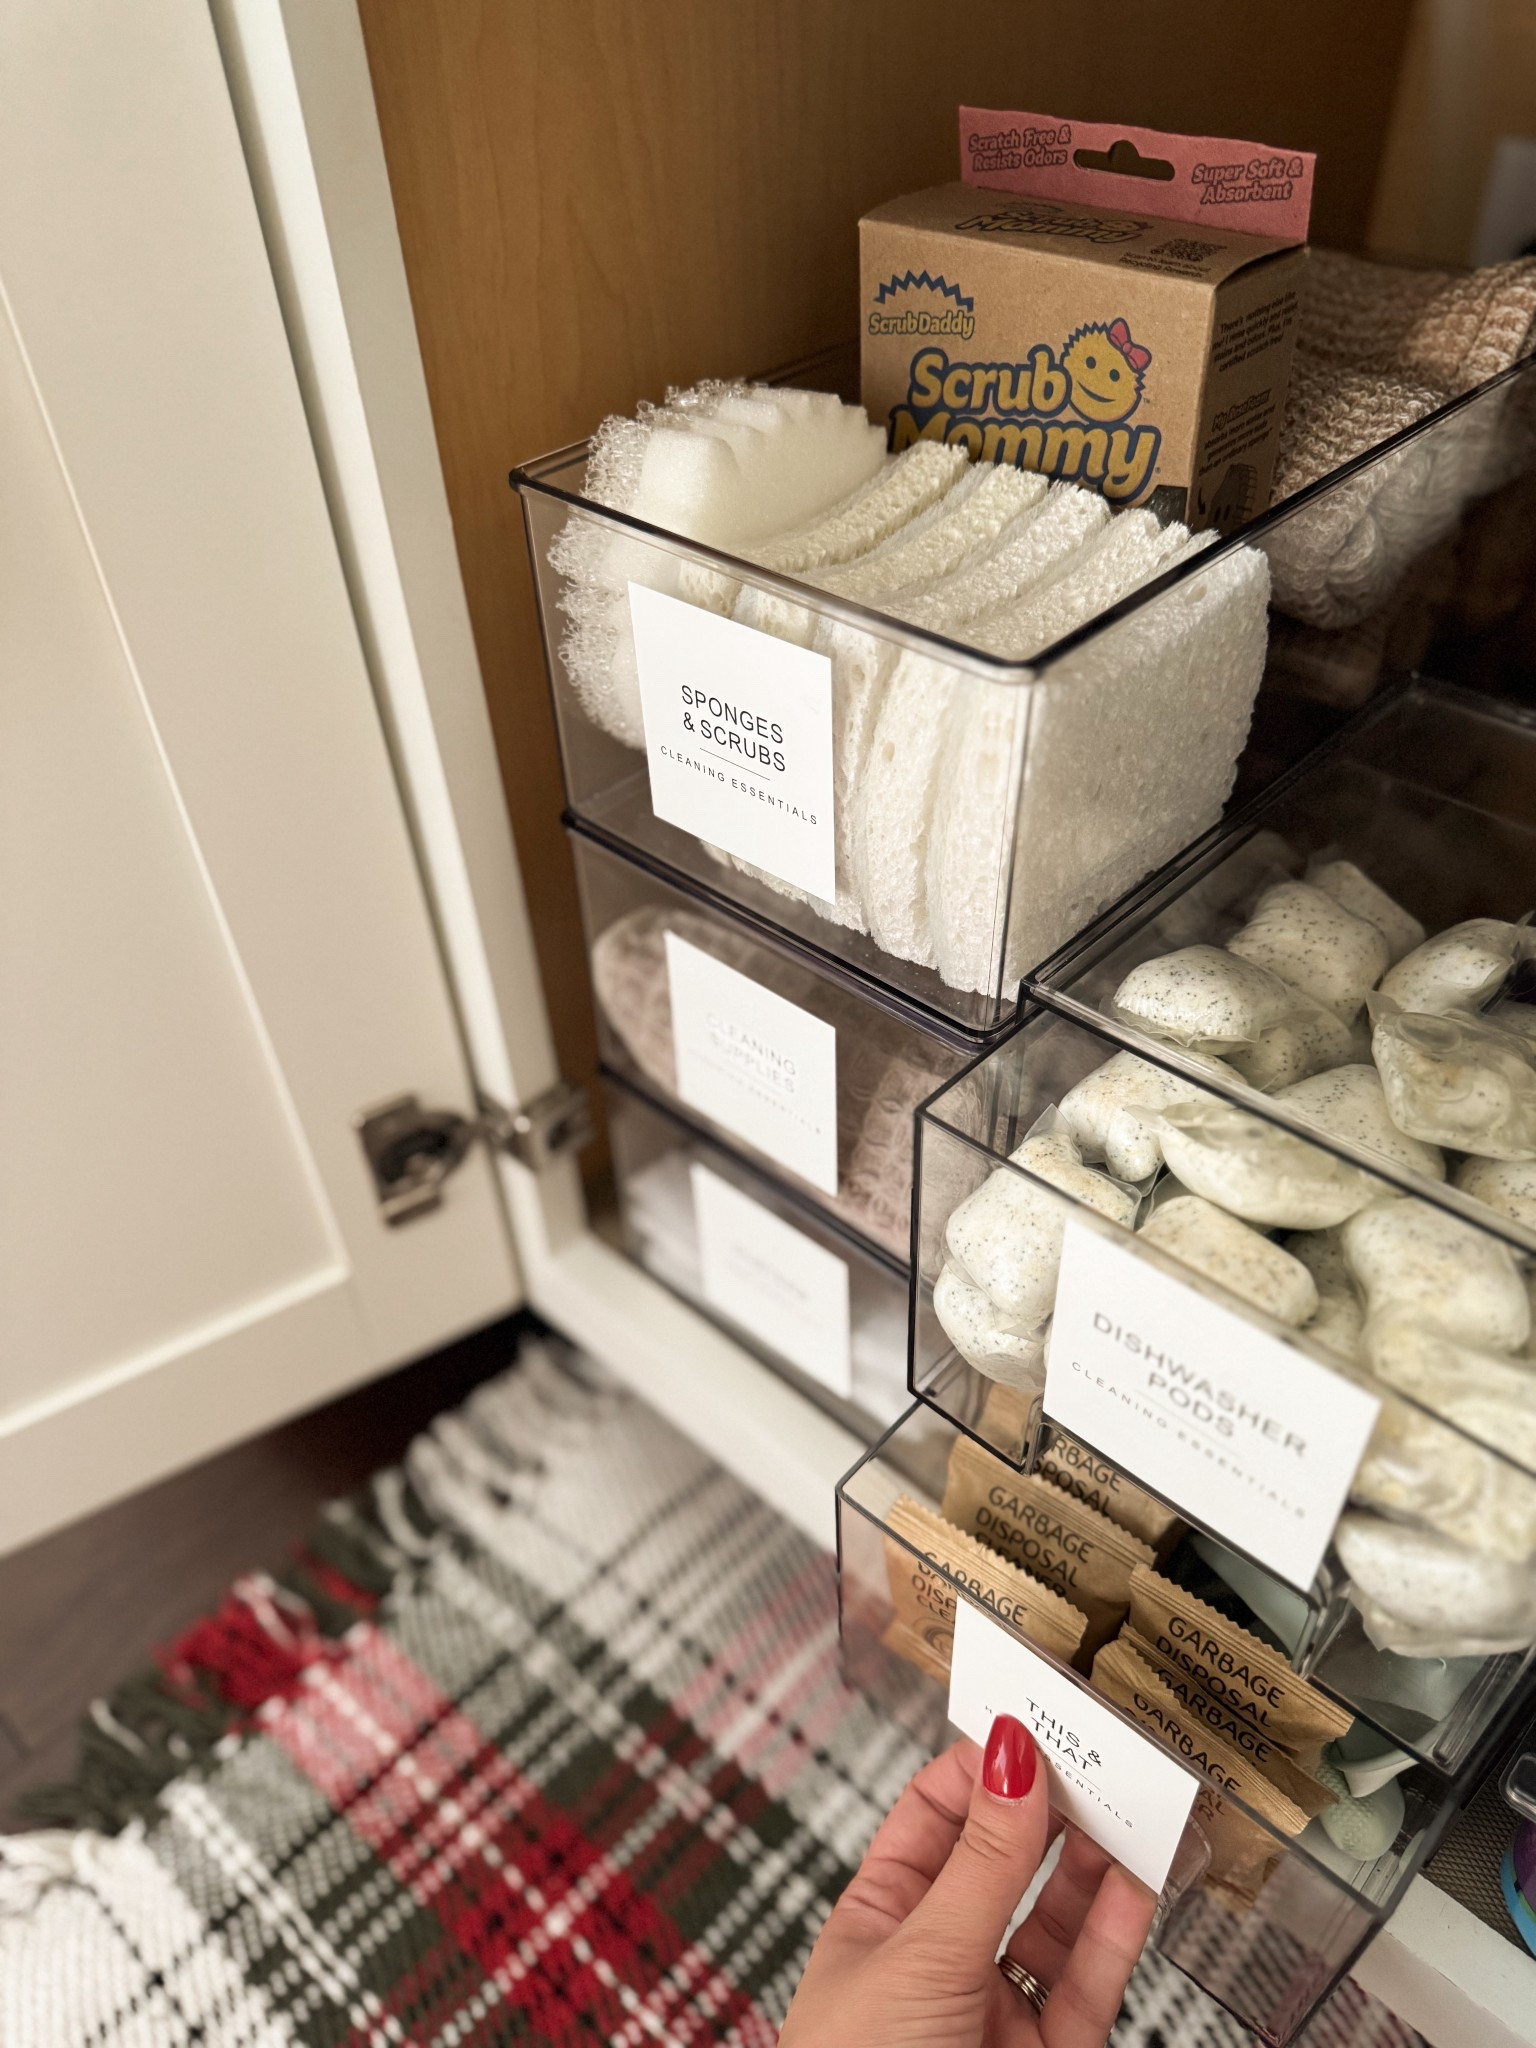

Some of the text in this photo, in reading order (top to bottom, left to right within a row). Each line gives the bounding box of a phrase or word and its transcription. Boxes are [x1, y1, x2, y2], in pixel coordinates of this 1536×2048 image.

[968, 124, 1071, 152] Scratch Free &
[973, 145, 1067, 172] Resists Odors
[1192, 157, 1303, 184] Super Soft &
[1201, 181, 1292, 204] Absorbent
[908, 346, 1070, 416] Scrub
[681, 685, 784, 744] SPONGES
[683, 711, 787, 772] & SCRUBS
[660, 745, 818, 825] CLEANING ESSENTIALS
[706, 1012, 796, 1076] CLEANING
[1092, 1311, 1308, 1458] DISHWASHER
[1147, 1371, 1235, 1438] PODS
[1051, 1435, 1121, 1493] RBAGE
[1071, 1361, 1306, 1519] CLEANING ESSENTIALS
[1033, 1456, 1111, 1518] SPOSAL
[975, 1506, 1078, 1588] DISPOSAL
[988, 1485, 1094, 1564] GARBAGE
[1156, 1636, 1271, 1728] DISPOSAL
[1168, 1616, 1285, 1709] GARBAGE
[1026, 1697, 1102, 1767] THIS &
[1031, 1716, 1093, 1770] THAT
[1133, 1692, 1242, 1791] GARBAGE
[1156, 1669, 1273, 1763] GARBAGE
[1042, 1753, 1133, 1828] SSENTIALS
